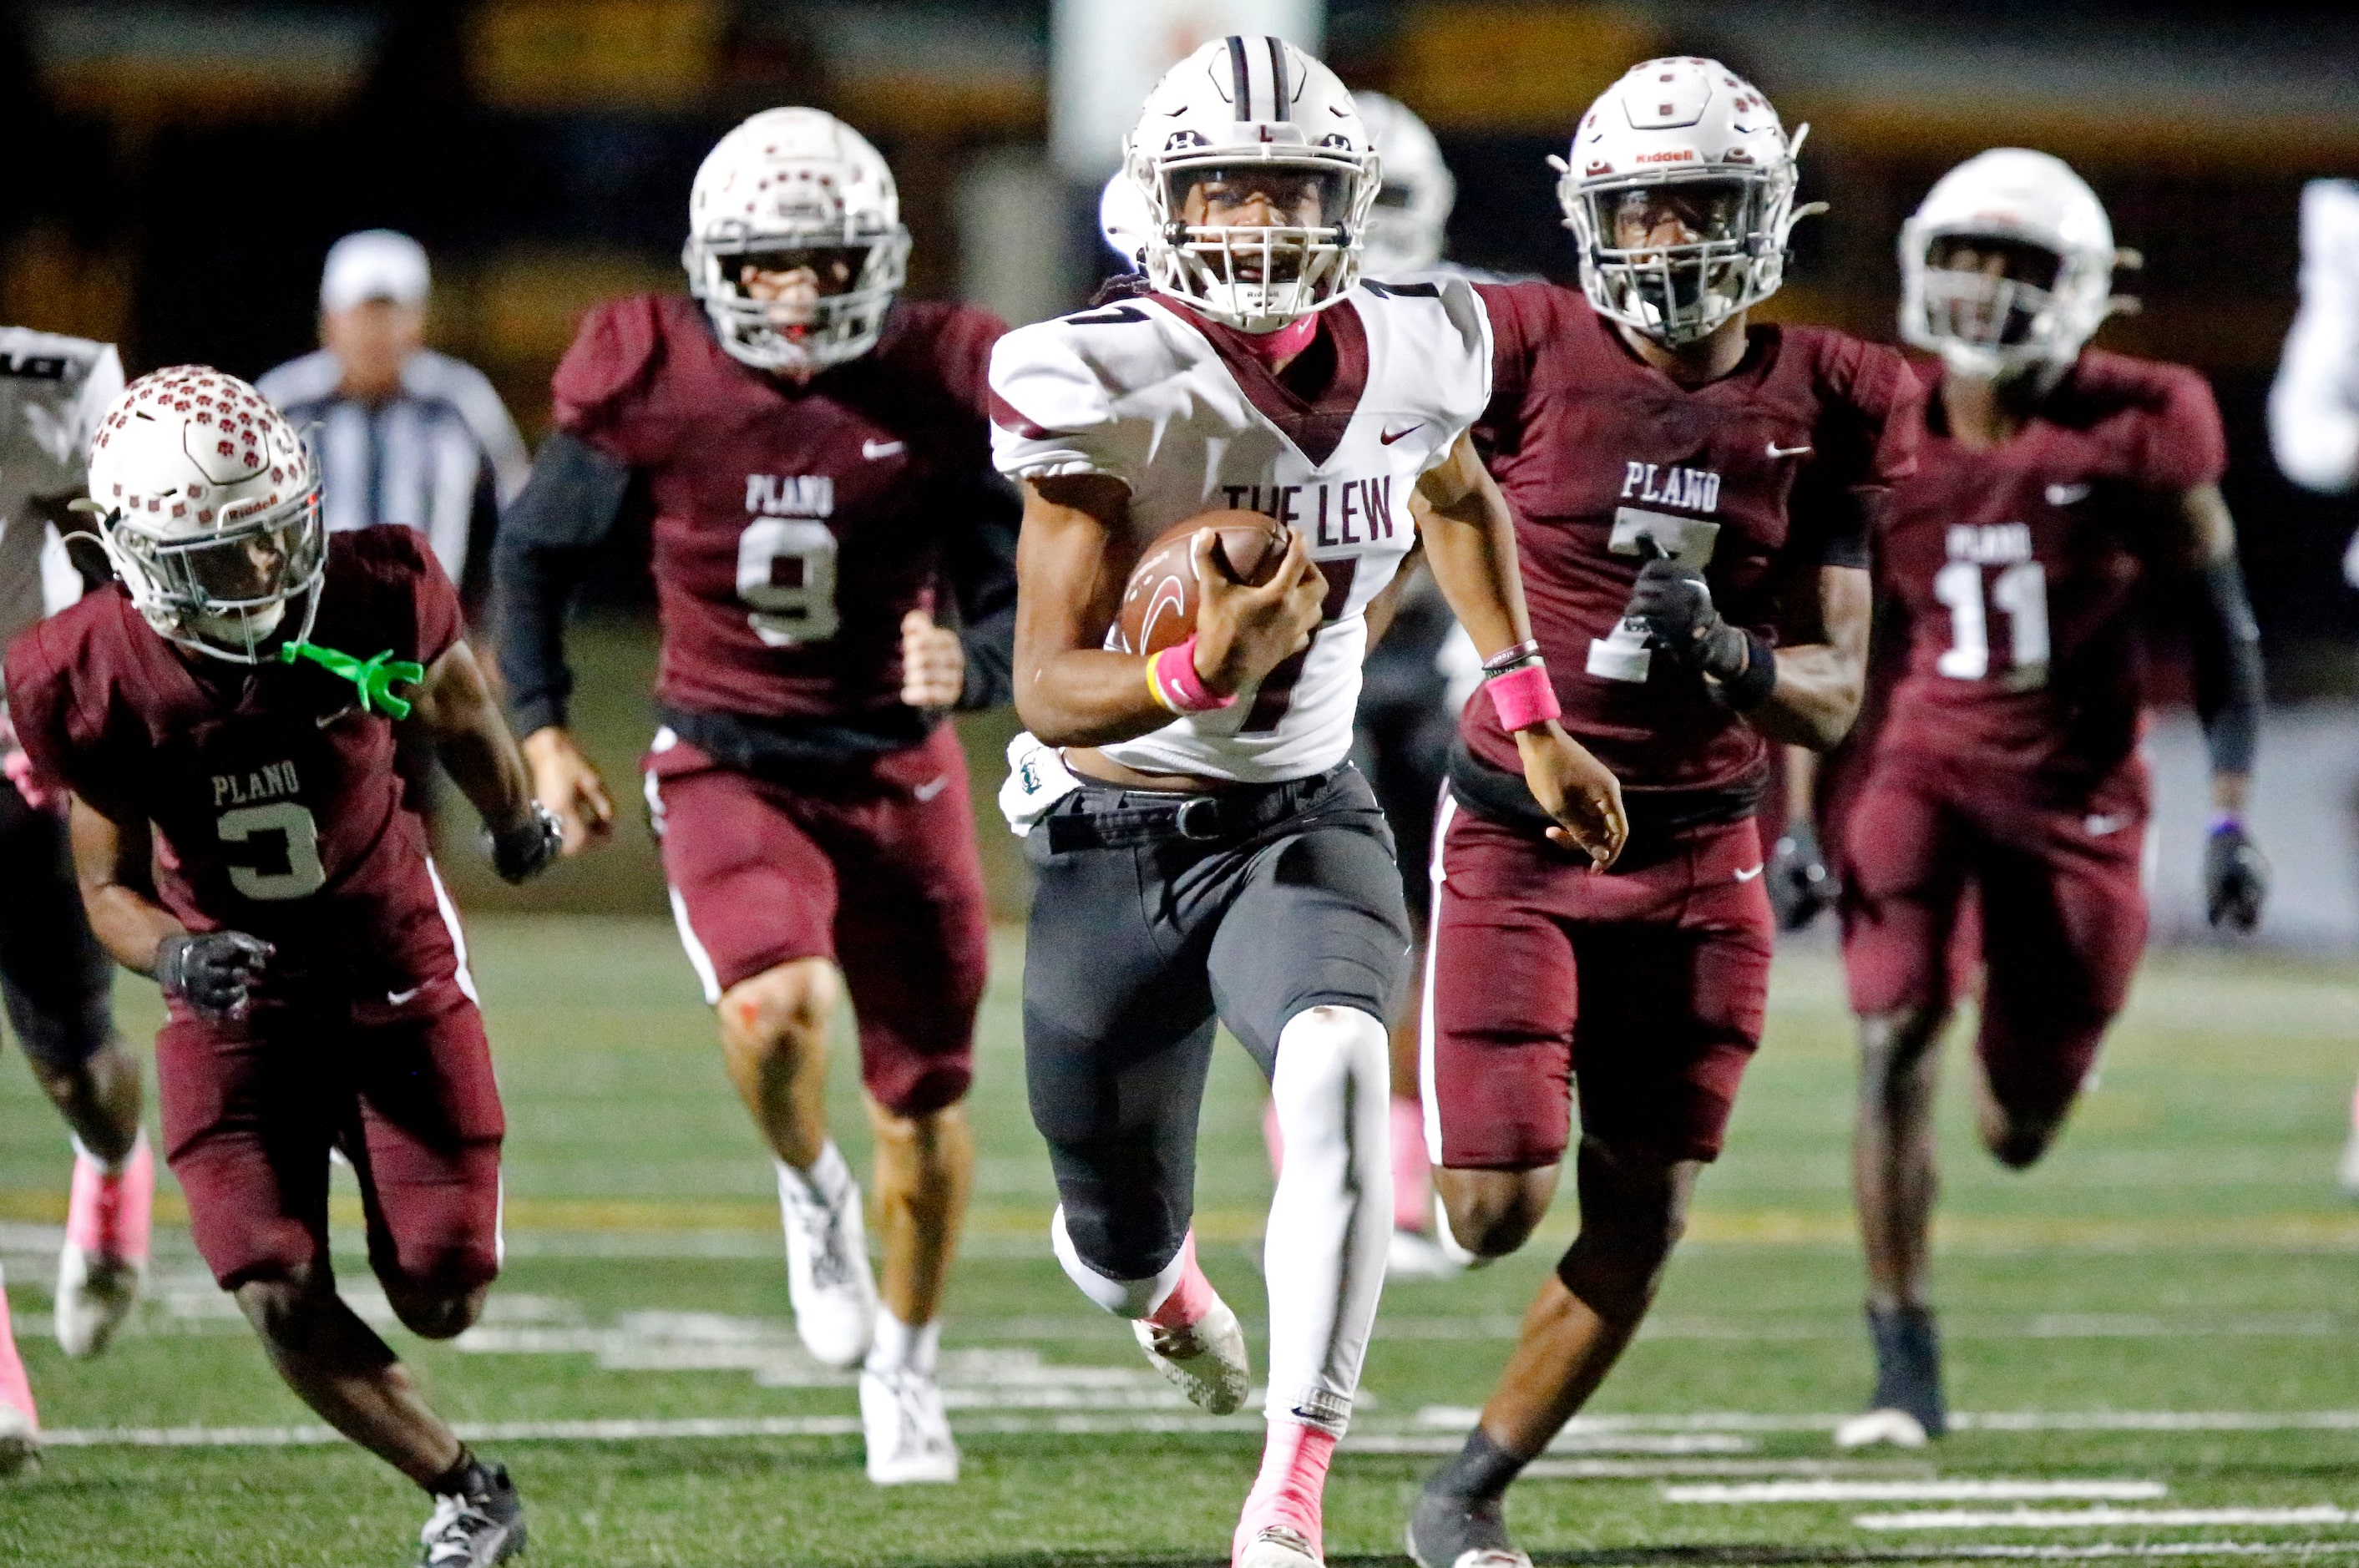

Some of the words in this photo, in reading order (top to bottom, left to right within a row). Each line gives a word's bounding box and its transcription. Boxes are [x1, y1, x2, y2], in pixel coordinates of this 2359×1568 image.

[1260, 124, 1273, 143] L
[1317, 474, 1394, 547] LEW
[1620, 461, 1721, 513] PLANO
[736, 515, 840, 649] 9
[1587, 505, 1722, 684] 7
[1933, 559, 2052, 693] 11
[210, 759, 301, 807] PLANO
